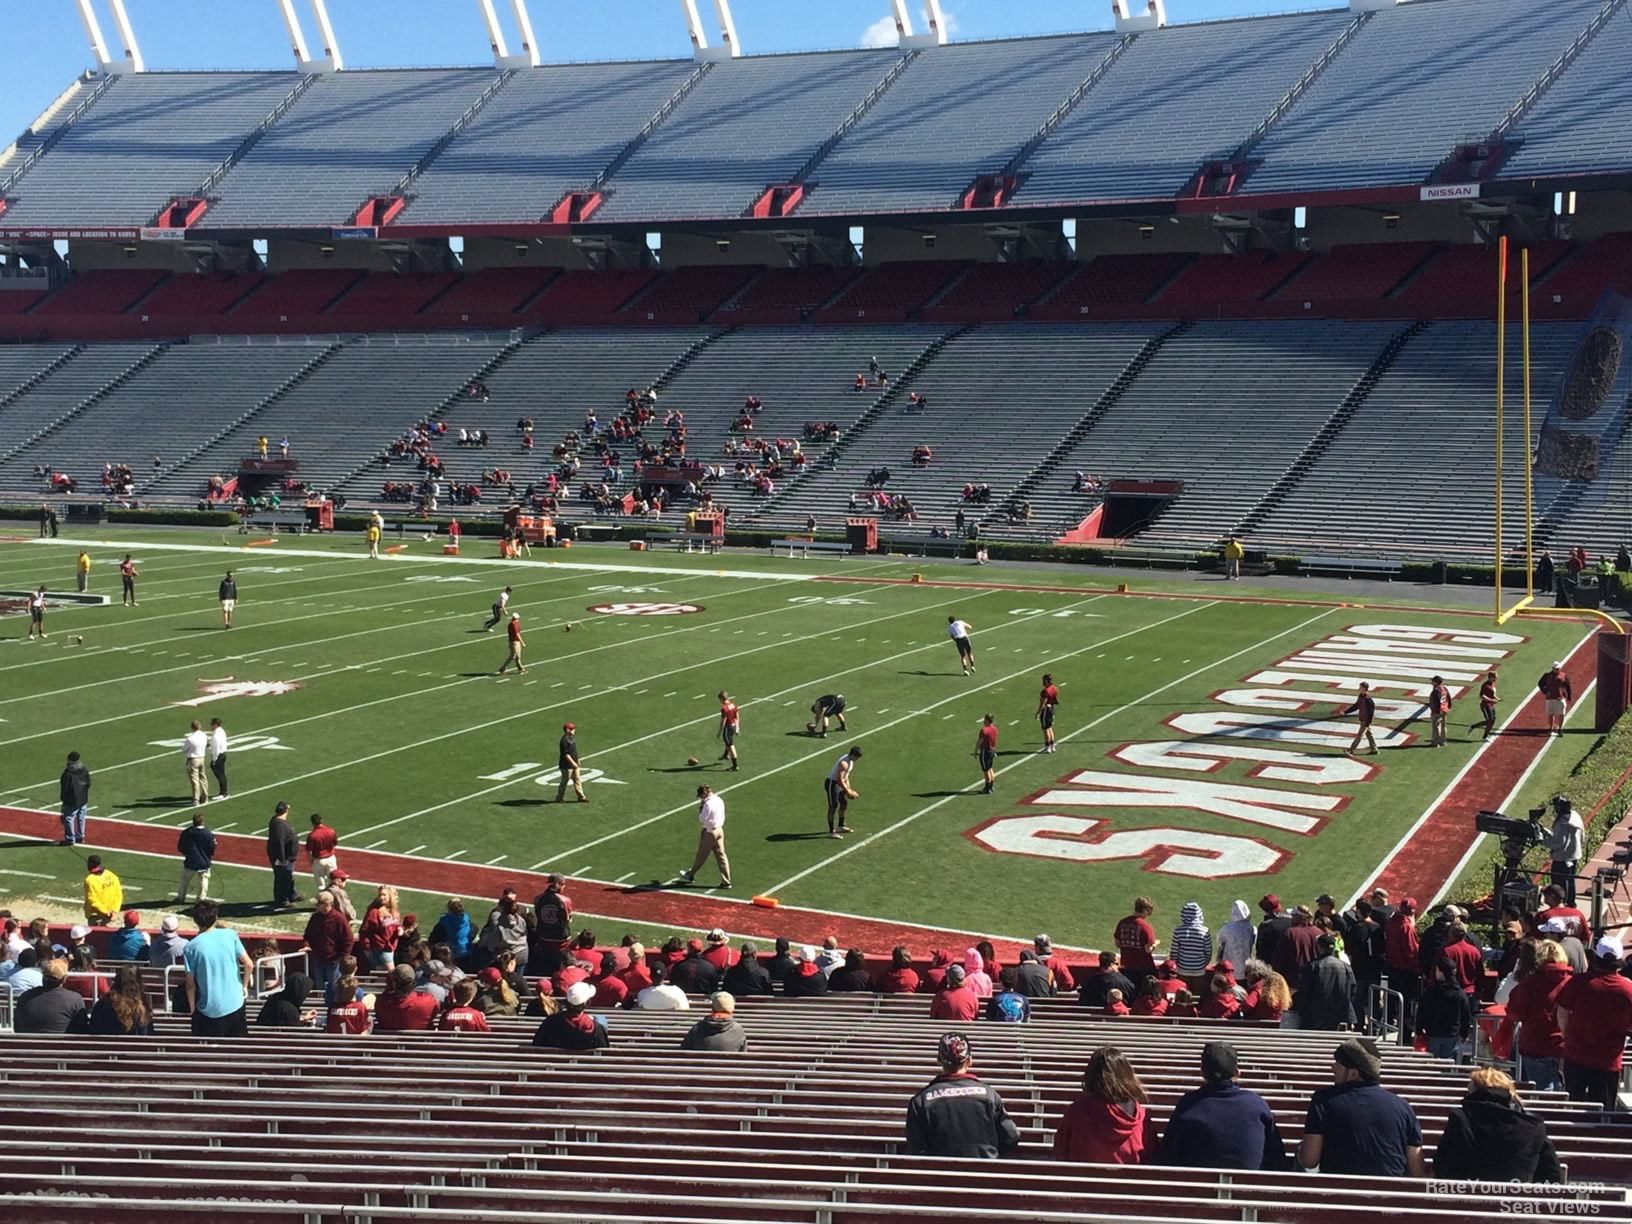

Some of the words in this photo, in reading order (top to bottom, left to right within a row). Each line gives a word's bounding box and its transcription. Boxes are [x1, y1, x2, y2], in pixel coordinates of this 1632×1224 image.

[1427, 187, 1473, 197] NISSAN
[1553, 295, 1562, 303] 18
[962, 623, 1530, 879] GAMECOCKS
[1366, 937, 1373, 956] 1
